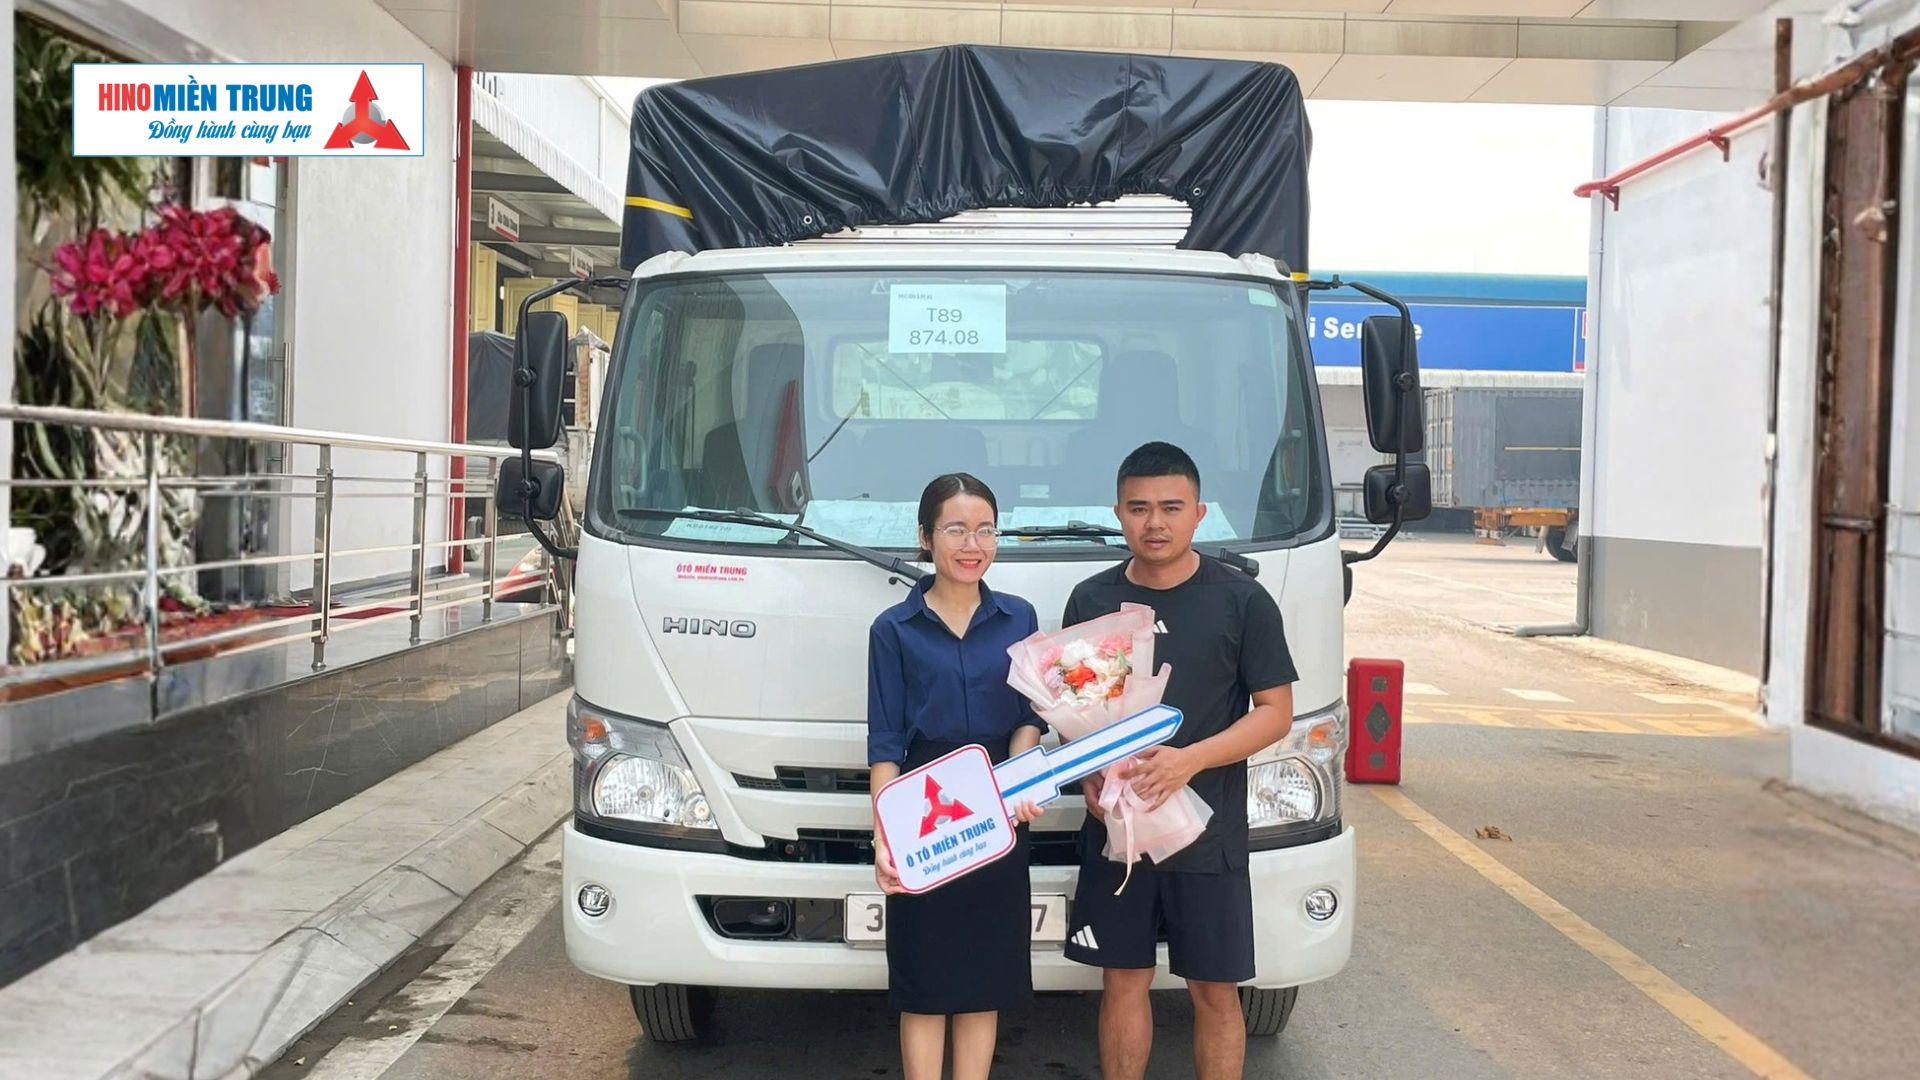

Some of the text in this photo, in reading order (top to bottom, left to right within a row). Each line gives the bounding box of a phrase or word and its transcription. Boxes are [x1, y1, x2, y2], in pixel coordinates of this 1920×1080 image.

[926, 307, 963, 323] T89
[909, 330, 979, 345] 874.08
[719, 566, 748, 575] TRUNG
[663, 617, 756, 638] HINO
[959, 817, 996, 842] TRUNG
